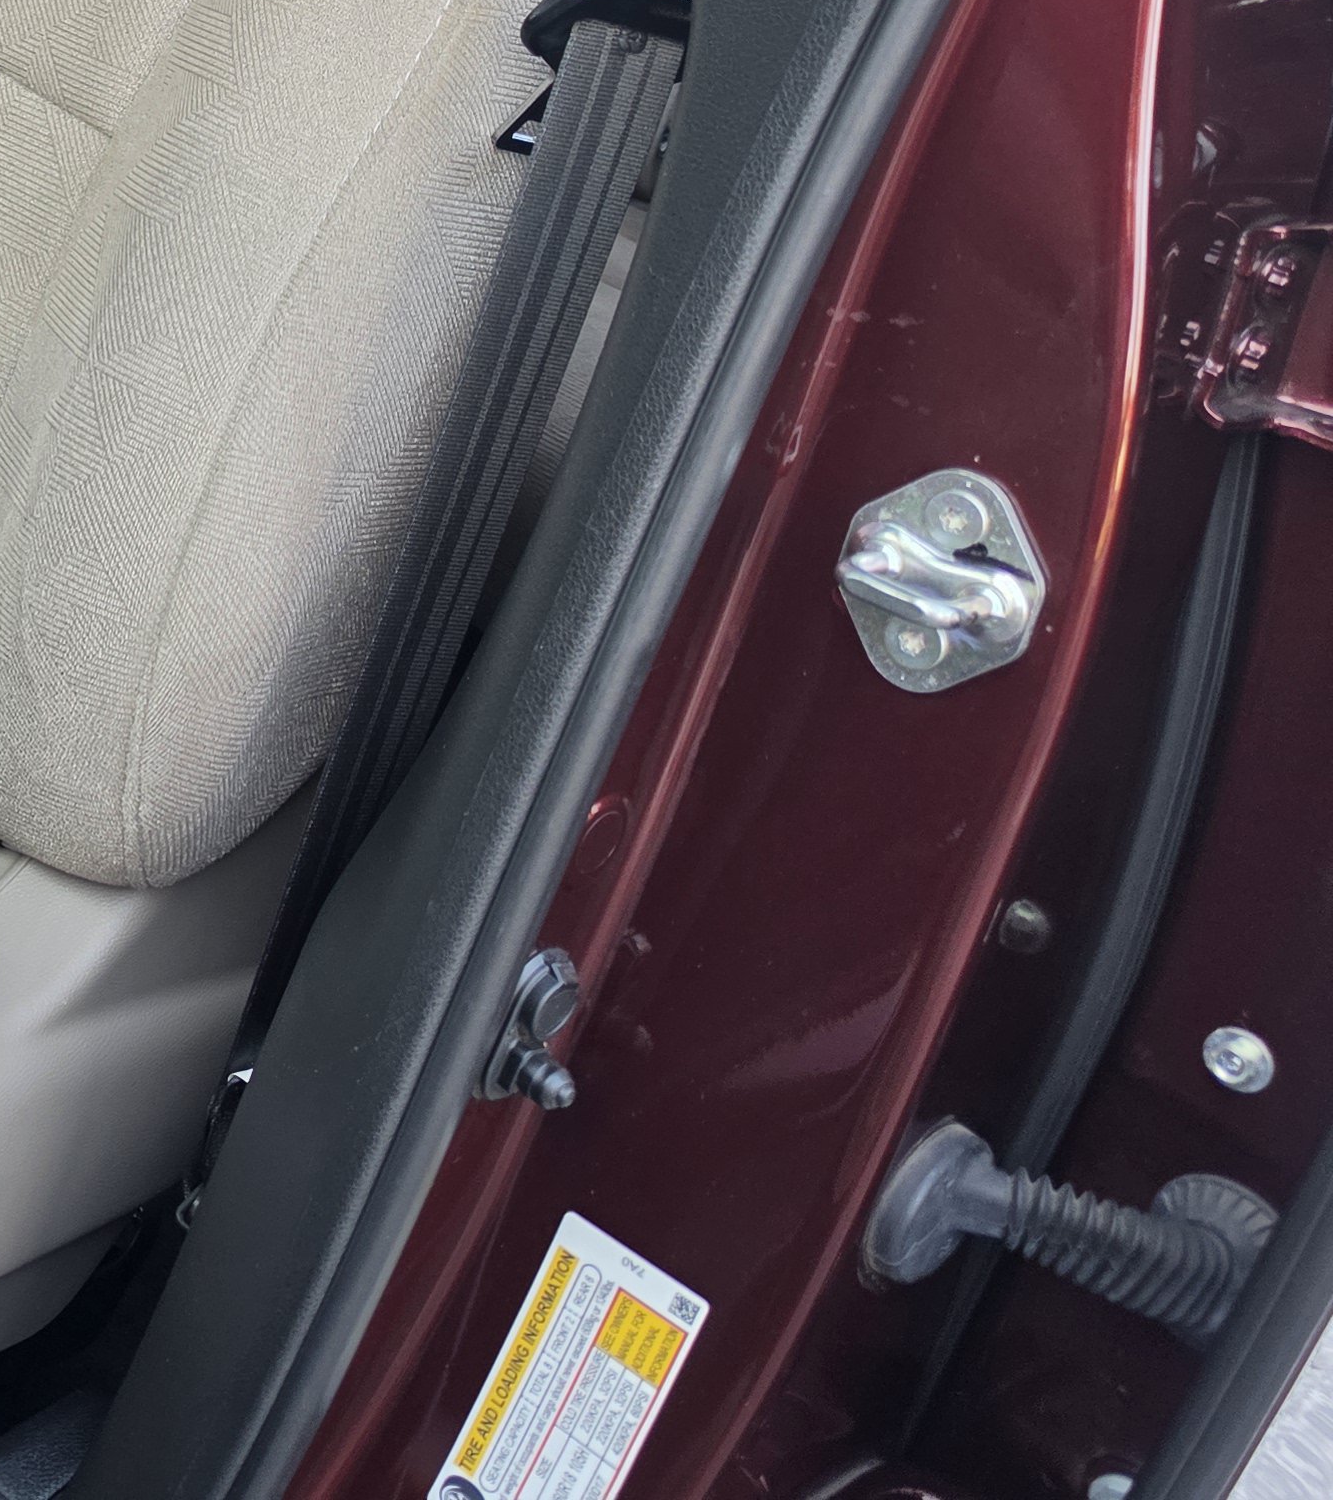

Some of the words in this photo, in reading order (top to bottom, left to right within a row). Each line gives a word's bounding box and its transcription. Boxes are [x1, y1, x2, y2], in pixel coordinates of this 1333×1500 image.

[572, 1280, 591, 1308] REAR
[549, 1321, 571, 1354] FRONT
[563, 1314, 574, 1325] 2
[600, 1331, 615, 1351] SEE
[615, 1329, 637, 1361] MANUAL
[630, 1309, 646, 1331] FOR
[630, 1325, 659, 1373] ADDITIONAL
[645, 1327, 679, 1384] INFORMATION
[459, 1437, 483, 1472] TIRE
[475, 1406, 499, 1440] AND
[491, 1343, 529, 1408] LOADING
[521, 1248, 575, 1345] INFORMATION
[528, 1367, 548, 1396] TOTAL
[559, 1405, 577, 1431] COLD
[570, 1387, 586, 1409] TIRE
[578, 1348, 605, 1391] PRESSURE
[484, 1444, 511, 1485] SEATING
[503, 1403, 532, 1448] CAPACITY
[535, 1456, 552, 1479] SIZE
